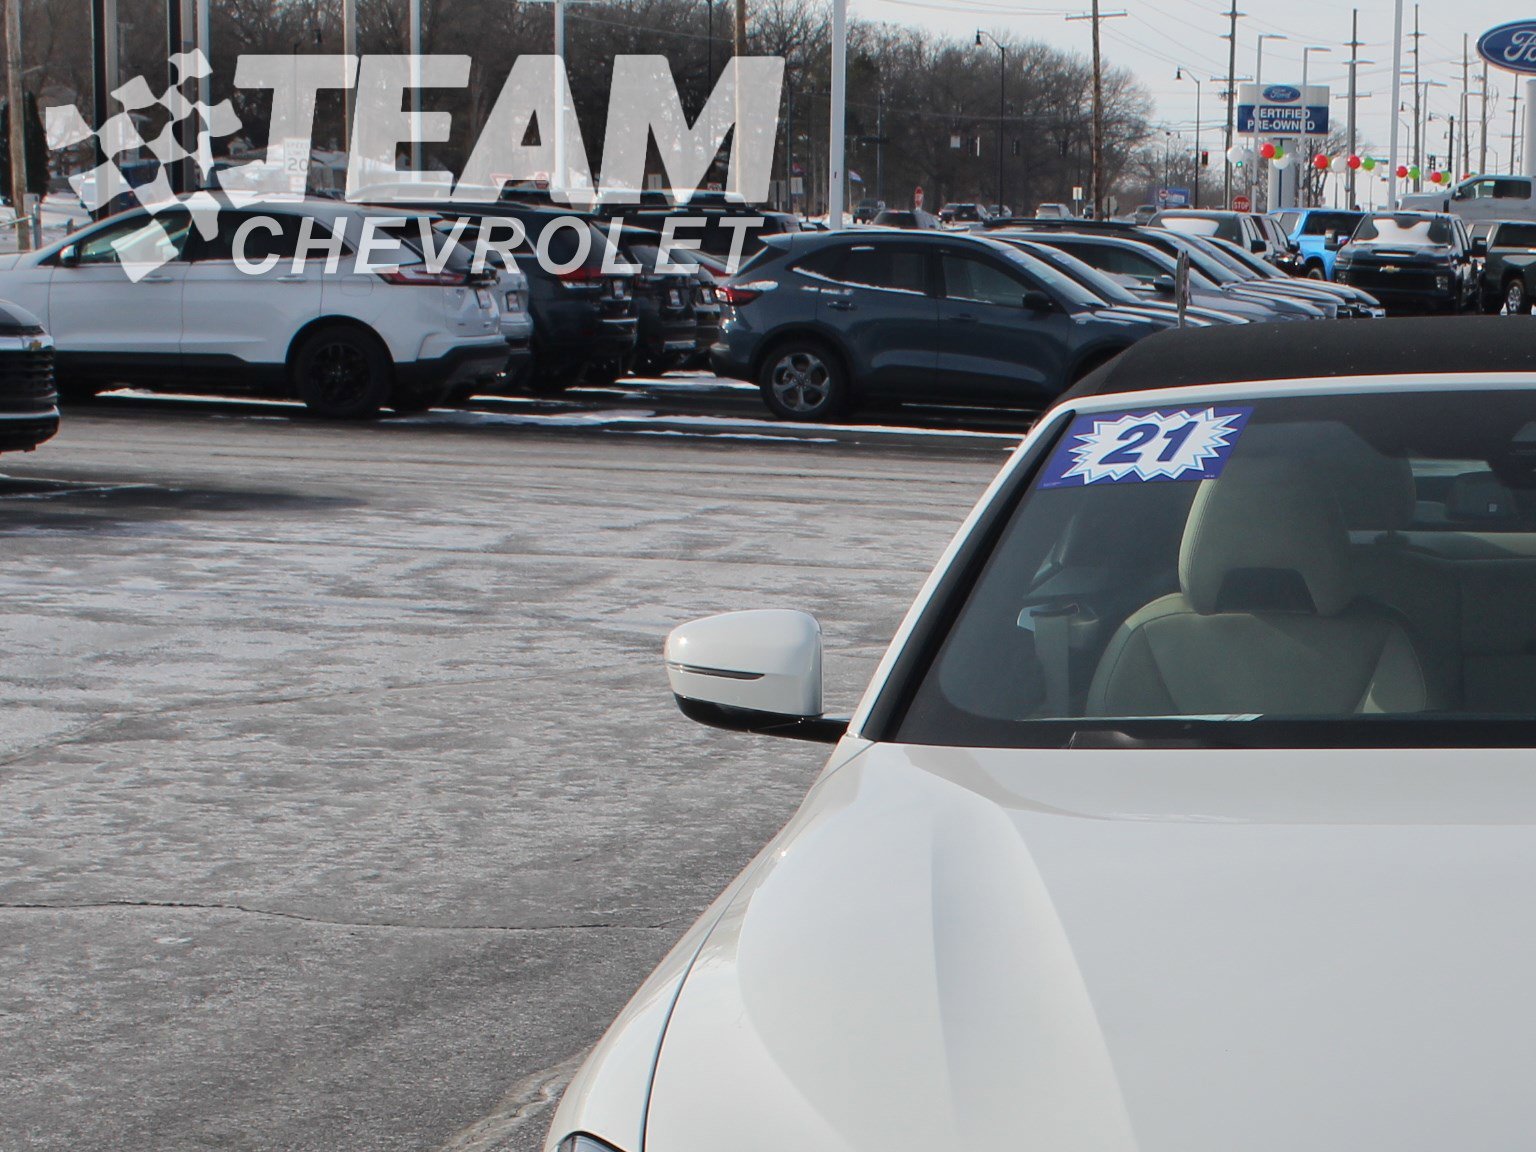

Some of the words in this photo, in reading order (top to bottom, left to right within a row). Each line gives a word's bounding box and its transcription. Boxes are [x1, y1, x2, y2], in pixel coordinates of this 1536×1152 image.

[1247, 120, 1315, 130] PE-OWND
[288, 157, 308, 171] 20
[1098, 420, 1199, 465] 21
